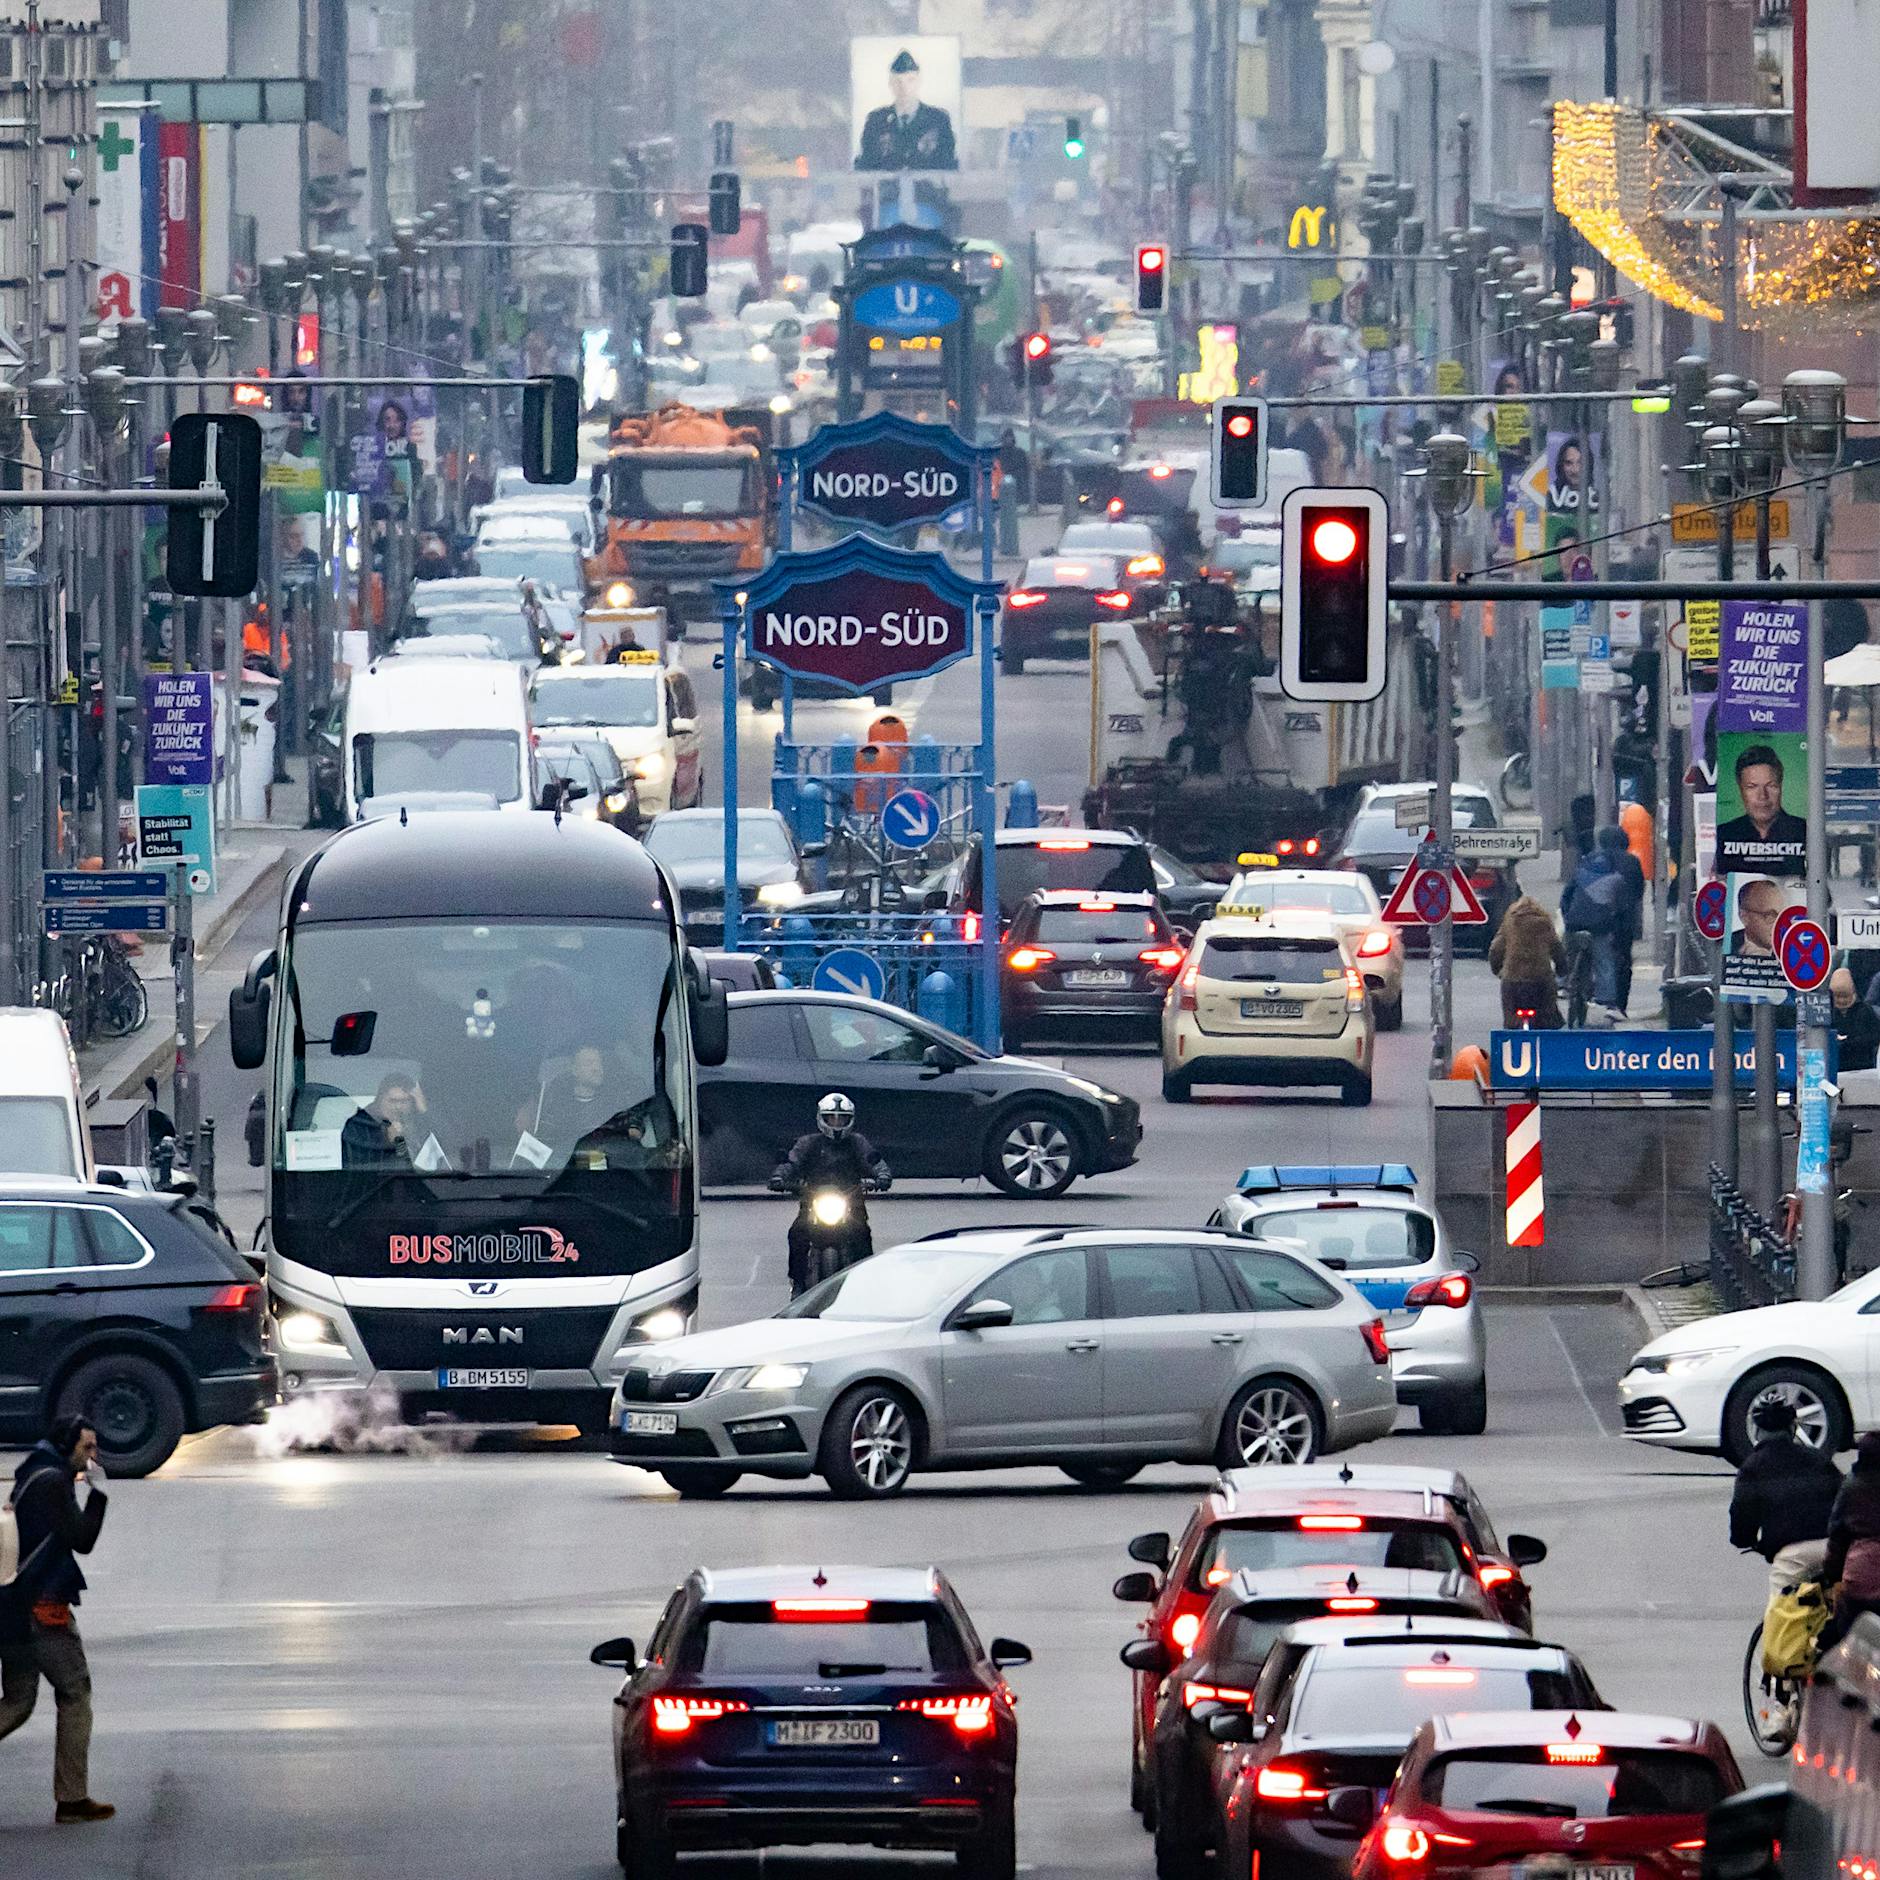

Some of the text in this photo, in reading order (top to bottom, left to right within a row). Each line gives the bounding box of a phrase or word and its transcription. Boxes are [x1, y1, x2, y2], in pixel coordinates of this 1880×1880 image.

[895, 286, 918, 314] U
[813, 467, 958, 498] NORD-SÜD
[1549, 484, 1599, 509] Vot
[766, 608, 949, 646] NORD-SÜD
[1742, 612, 1795, 628] HOLEN
[1735, 626, 1801, 645] WIR UNS
[1752, 645, 1780, 659] DIE
[1728, 660, 1804, 678] ZUKUNFT
[158, 681, 196, 693] HOLEN
[1731, 675, 1798, 693] ZURÜCK
[154, 694, 202, 708] WIR UNS
[167, 709, 187, 721] DIE
[1749, 710, 1776, 723] Volt
[152, 723, 206, 735] ZUKUNFT
[144, 818, 189, 829] Stabilität
[145, 832, 169, 842] statt
[1453, 835, 1532, 852] Behrenstraße
[146, 845, 180, 855] Chaos.
[1723, 842, 1806, 856] ZUVERSICHT.
[1502, 1039, 1532, 1077] U
[1585, 1047, 1650, 1071] Unter
[1657, 1046, 1700, 1071] den
[443, 1327, 524, 1344] MAN
[827, 1722, 874, 1741] 2300
